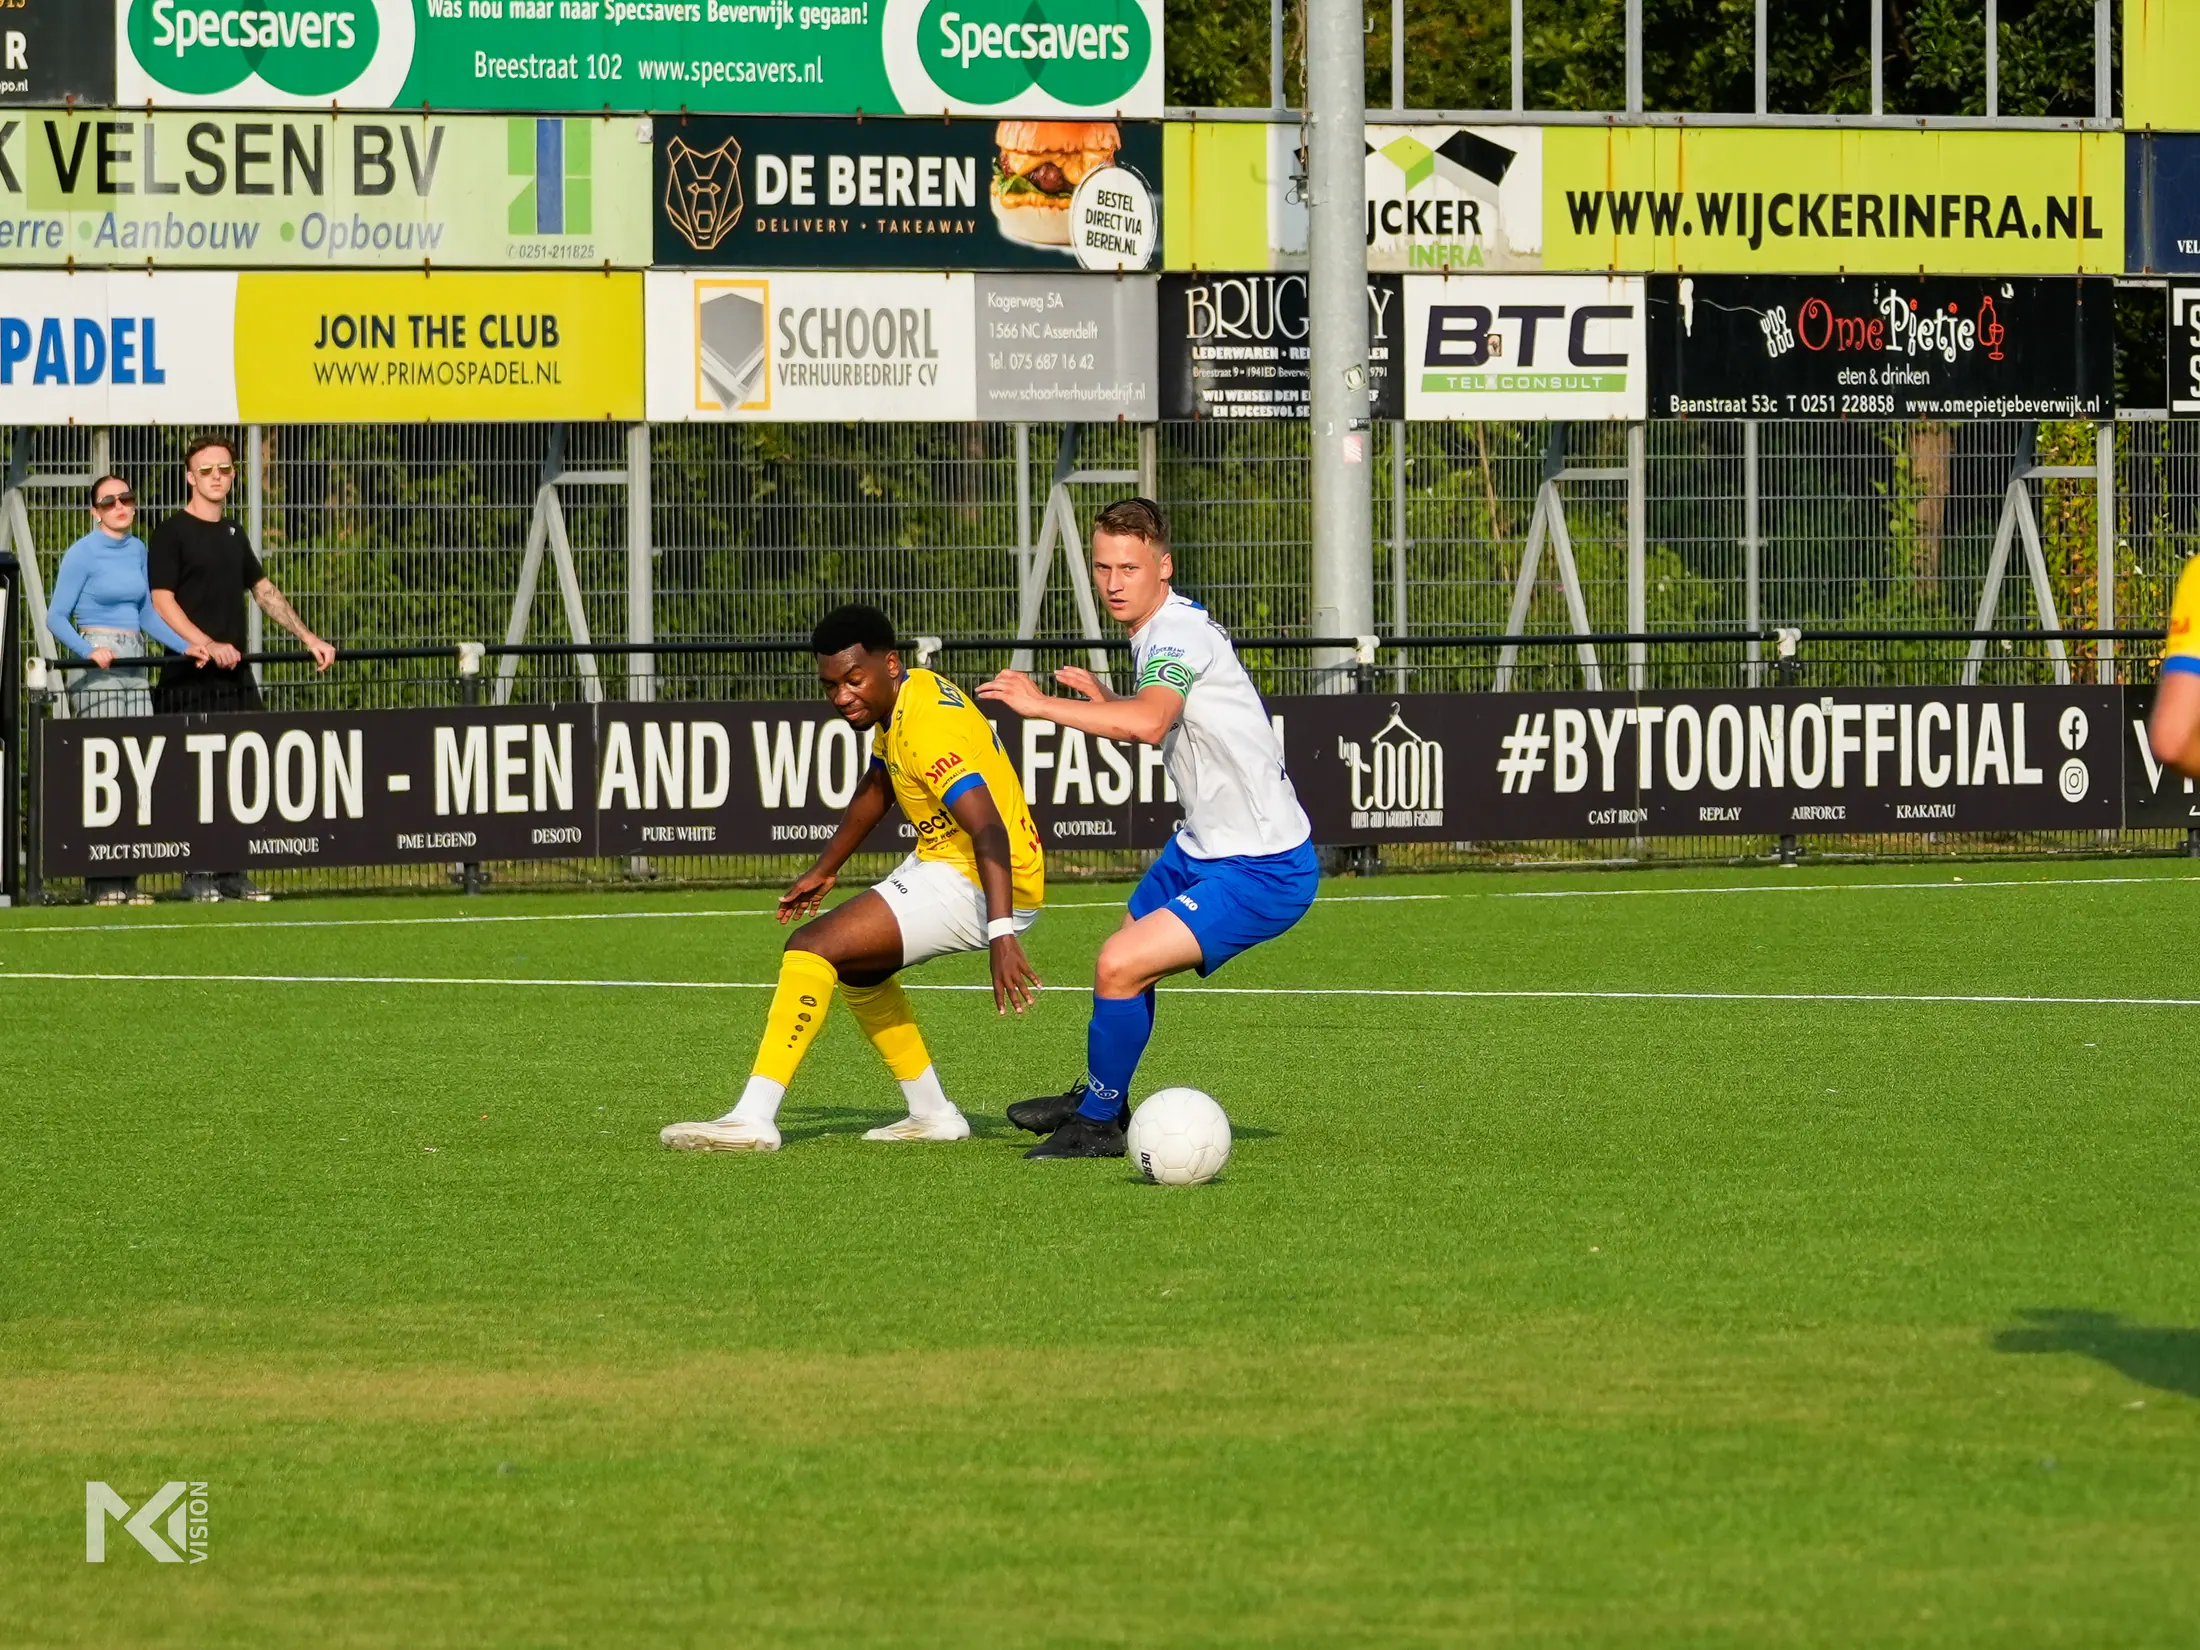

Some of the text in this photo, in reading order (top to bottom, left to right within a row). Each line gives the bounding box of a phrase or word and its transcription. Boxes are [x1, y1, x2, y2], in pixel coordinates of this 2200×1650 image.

[428, 0, 869, 29] Was nou maar naar Specsavers Beverwijk gegaan!
[152, 0, 356, 57] Specsavers
[940, 11, 1130, 68] Specsavers
[474, 50, 823, 87] Breestraat 102 www.specsavers.nl
[0, 78, 29, 95] po.nl
[44, 120, 324, 196] VELSEN
[354, 124, 445, 197] BV
[756, 154, 977, 207] DE BEREN
[1097, 190, 1134, 212] BESTEL
[756, 219, 977, 235] DELIVERY TAKEAWAY
[1085, 208, 1142, 235] DIRECT VIA
[1565, 191, 2103, 251] WWW.WIJCKERINFRA.NL
[94, 211, 260, 249] Aanbouw
[301, 212, 444, 258] Opbouw
[1086, 230, 1137, 256] BEREN.NL
[519, 244, 595, 259] 0251-211825
[1409, 244, 1484, 268] INFRA
[987, 292, 1064, 313] Kagerweg 5A
[313, 314, 560, 350] JOIN THE CLUB
[779, 307, 939, 361] SCHOORL
[989, 321, 1098, 339] 1566 NC Assendelft
[1424, 305, 1634, 367] BTC
[0, 317, 166, 386] PADEL
[988, 353, 1095, 370] Tel. 075 687 16 42
[1192, 347, 1279, 360] LEDERWAREN
[313, 362, 561, 386] WWW.PRIMOSPADEL.NL
[779, 363, 937, 387] VERHUURBEDRIJF CV
[1193, 366, 1232, 378] Breestraat
[1278, 366, 1310, 379] Beverwij
[1447, 376, 1603, 390] TELCONSULT
[1837, 366, 1867, 385] eten
[1881, 363, 1930, 385] drinken
[1203, 390, 1224, 402] WIJ
[1225, 390, 1273, 402] WENSEN
[1669, 395, 2100, 418] Baanstraat 53c T 0251 228858 www.omepietjebeverwijk.nl
[1213, 406, 1228, 418] EN
[1230, 405, 1294, 418] SUCCESVOL
[1497, 702, 2043, 794] #BYTOONOFFICIAL
[82, 736, 167, 828] BY
[186, 729, 365, 825] TOON
[433, 723, 574, 815] MEN
[598, 721, 732, 810] AND
[1589, 808, 1648, 824] CAST IRON
[1699, 807, 1742, 821] REPLAY
[1791, 806, 1846, 820] AIRFORCE
[1896, 804, 1956, 819] KRAKATAU
[532, 828, 582, 844] DESOTO
[642, 827, 716, 843] PURE WHITE
[772, 825, 807, 841] HUGO
[1053, 819, 1117, 838] QUOTRELL
[89, 842, 191, 861] XPLCT STUDIO'S
[248, 837, 319, 856] MATINIQUE
[397, 833, 476, 850] PME LEGEND
